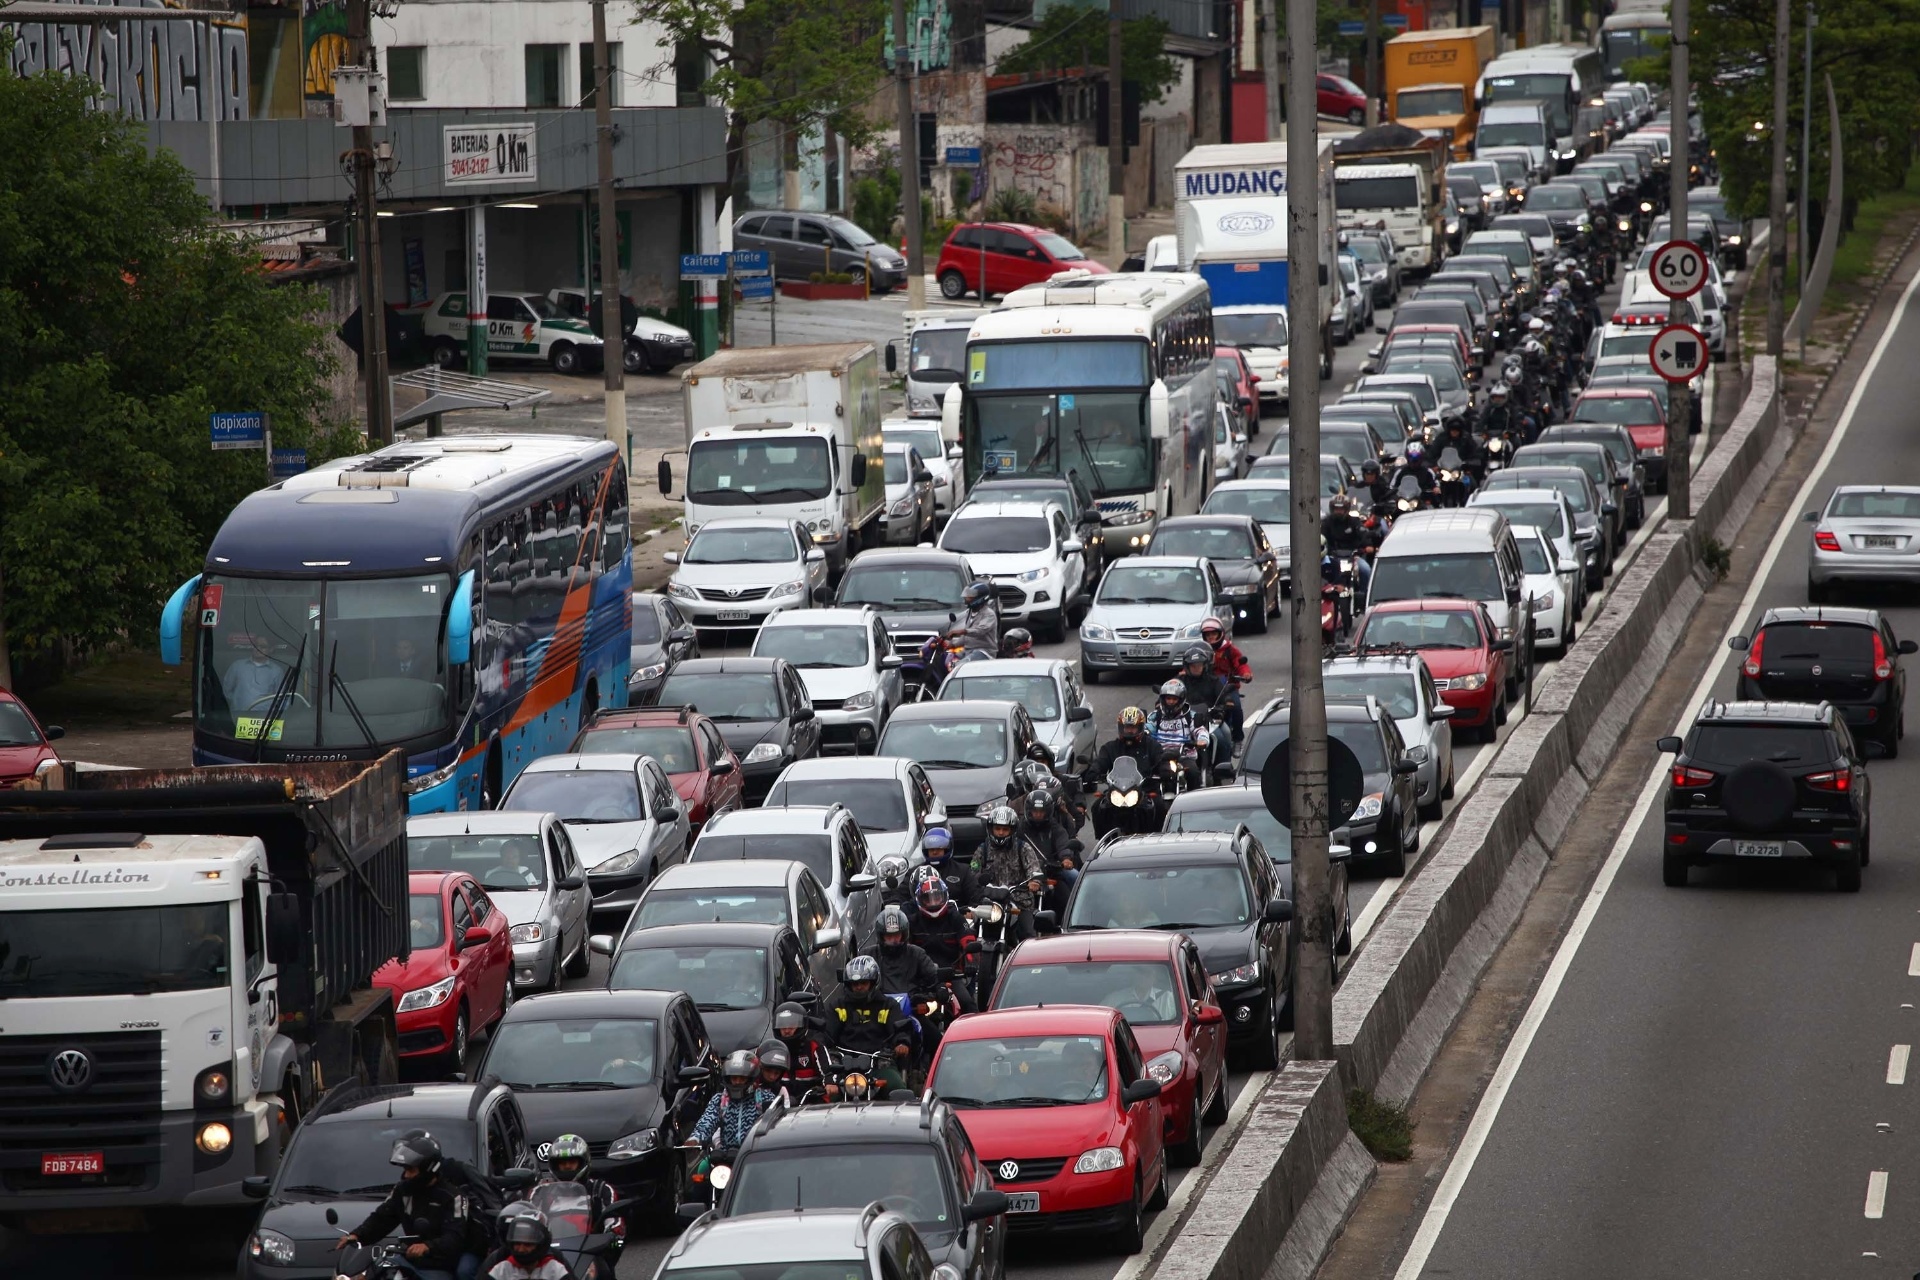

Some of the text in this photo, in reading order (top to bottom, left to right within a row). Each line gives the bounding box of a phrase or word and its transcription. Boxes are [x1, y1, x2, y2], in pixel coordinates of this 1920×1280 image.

[451, 135, 489, 153] BATERIAS
[508, 133, 529, 173] Km
[452, 158, 490, 175] 5041-2187
[1186, 169, 1287, 196] MUDANÇ
[1660, 253, 1697, 278] 60
[973, 371, 981, 380] F
[213, 415, 260, 432] Uapixana
[1001, 457, 1011, 467] 10
[204, 611, 215, 622] R
[286, 754, 348, 762] Marcopolo
[44, 1160, 98, 1172] FDB-7484
